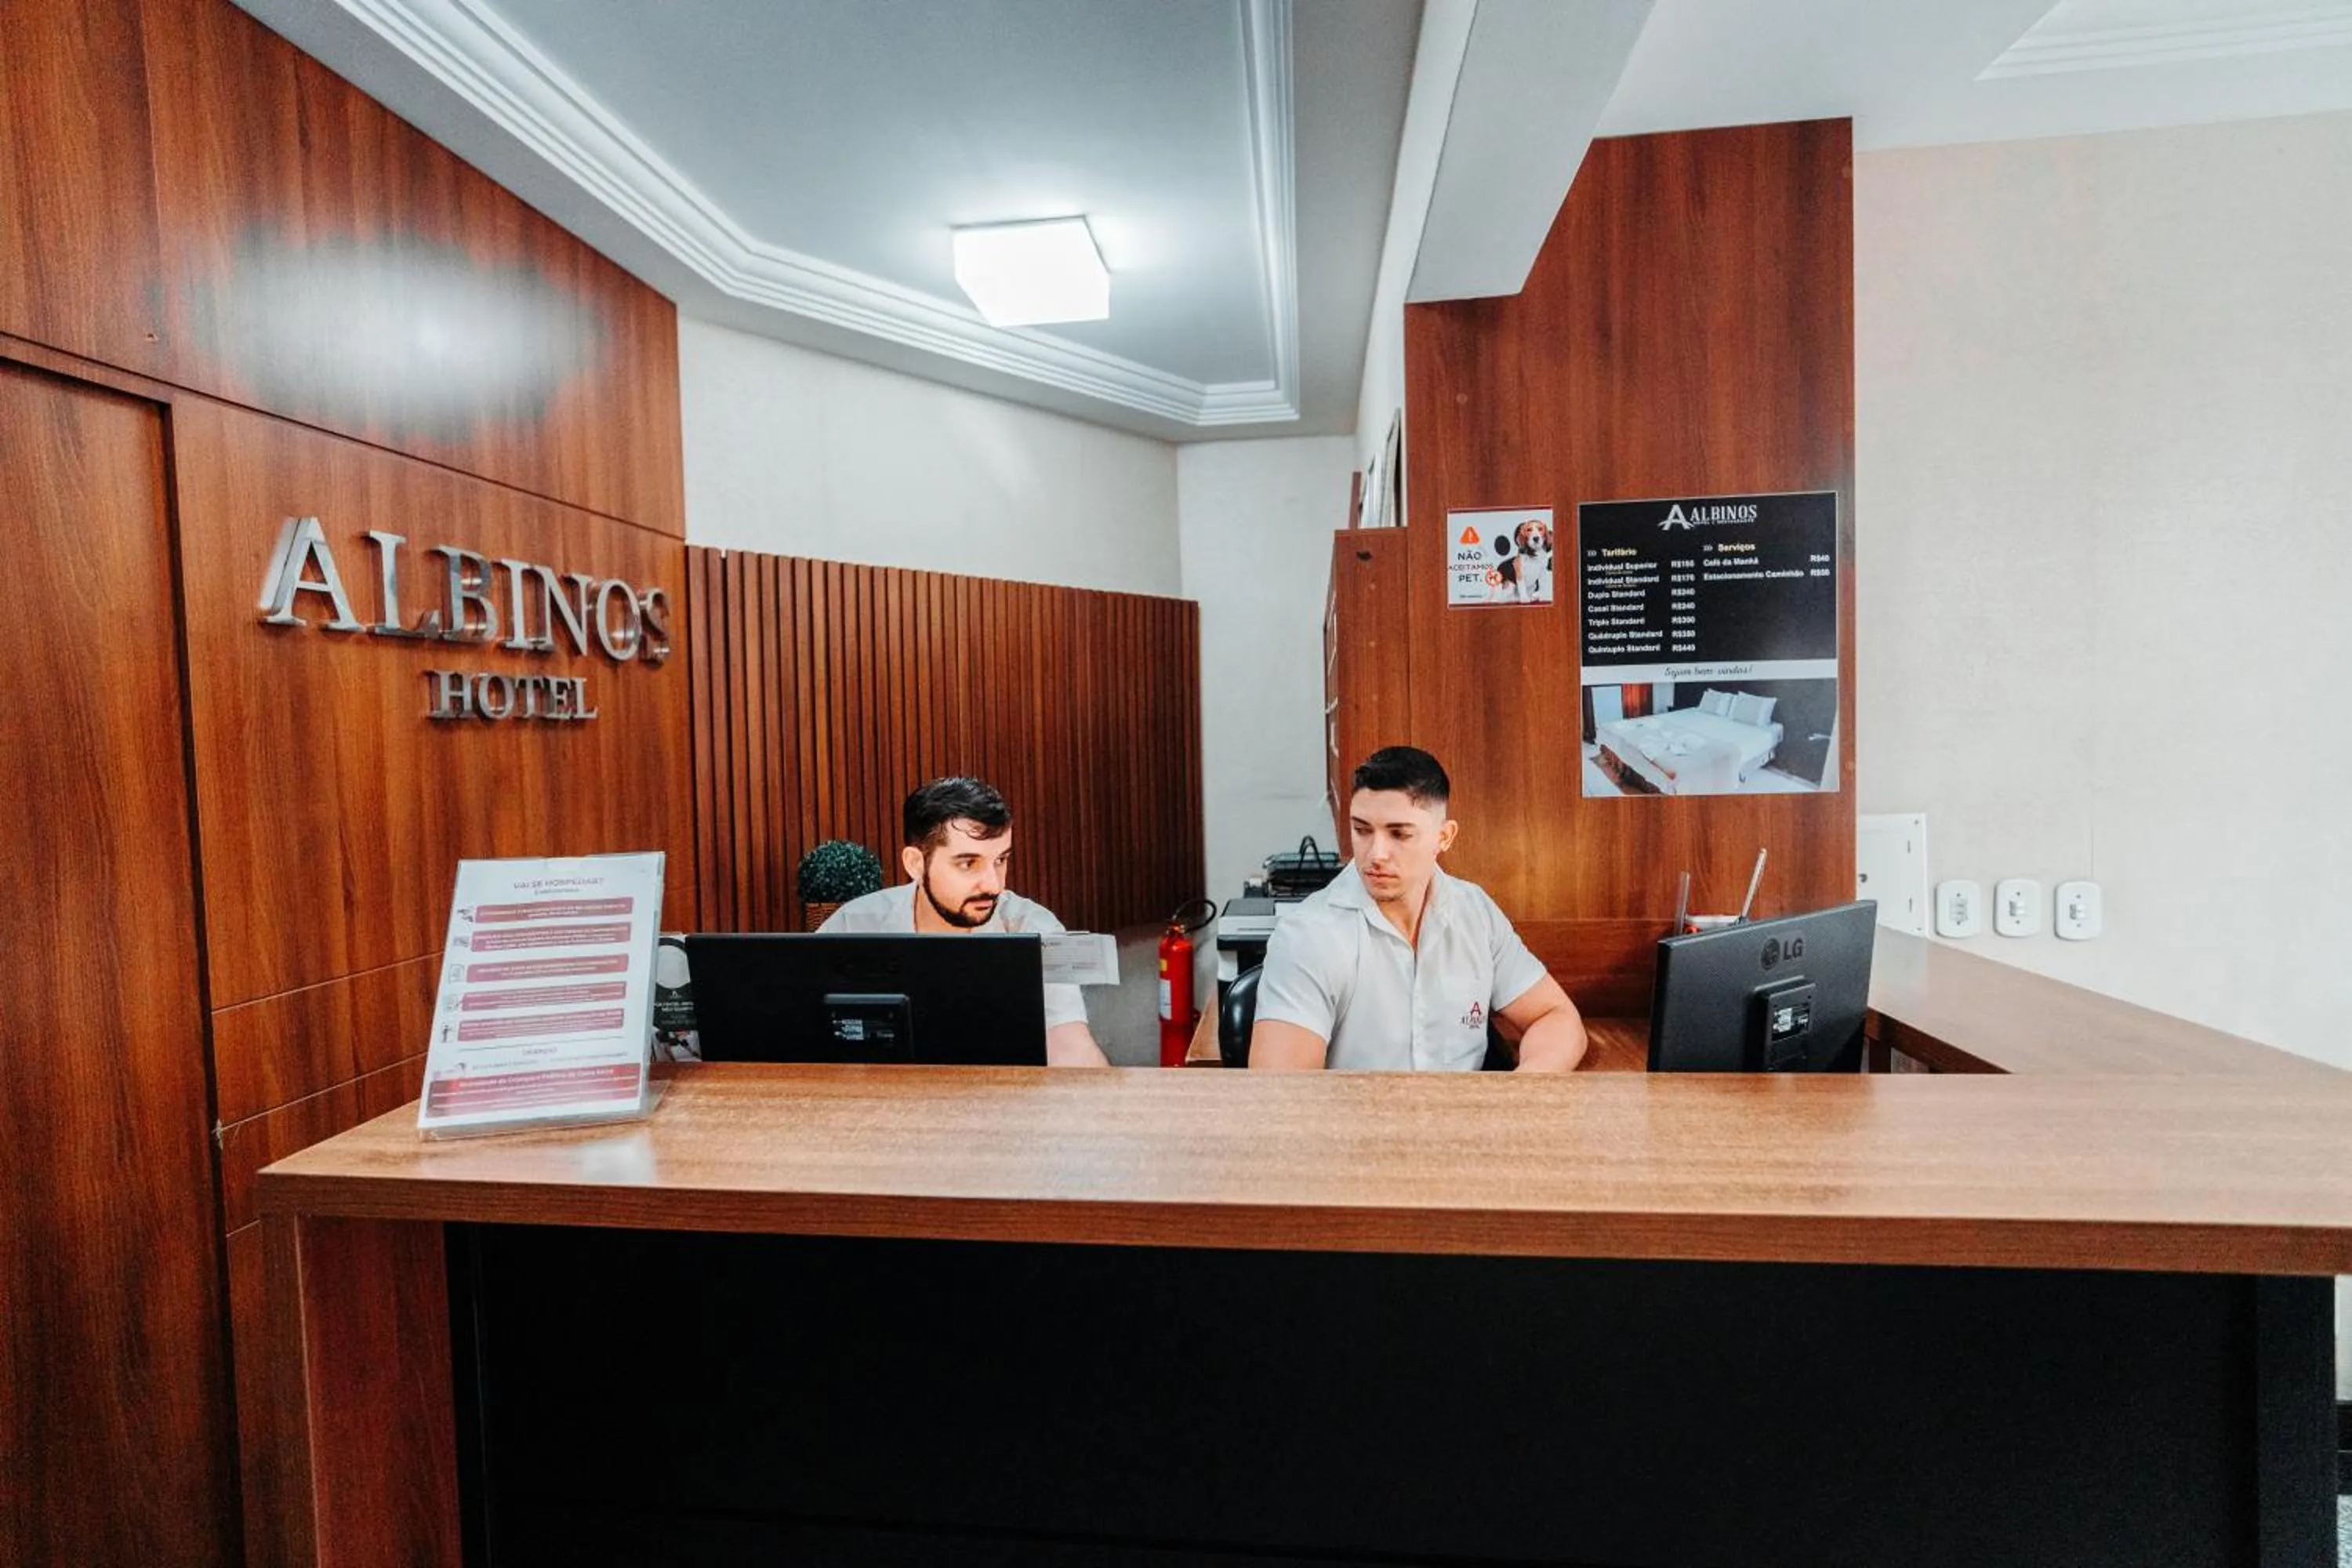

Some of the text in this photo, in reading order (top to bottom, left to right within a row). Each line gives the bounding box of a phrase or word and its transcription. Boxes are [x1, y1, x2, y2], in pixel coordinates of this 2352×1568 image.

[1690, 504, 1757, 521] ALBINOS
[1718, 543, 1755, 552] Serviços
[1457, 550, 1482, 561] NÃO
[1587, 563, 1624, 572] Individual
[1624, 562, 1658, 571] Superior
[1458, 574, 1483, 583] PET.
[1587, 577, 1624, 586] Individual
[260, 517, 671, 665] ALBINOS
[1588, 591, 1610, 600] Duplo
[1612, 589, 1646, 597] Standard
[1588, 619, 1610, 627] Triplo
[426, 669, 598, 719] HOTEL
[1784, 938, 1803, 960] LG
